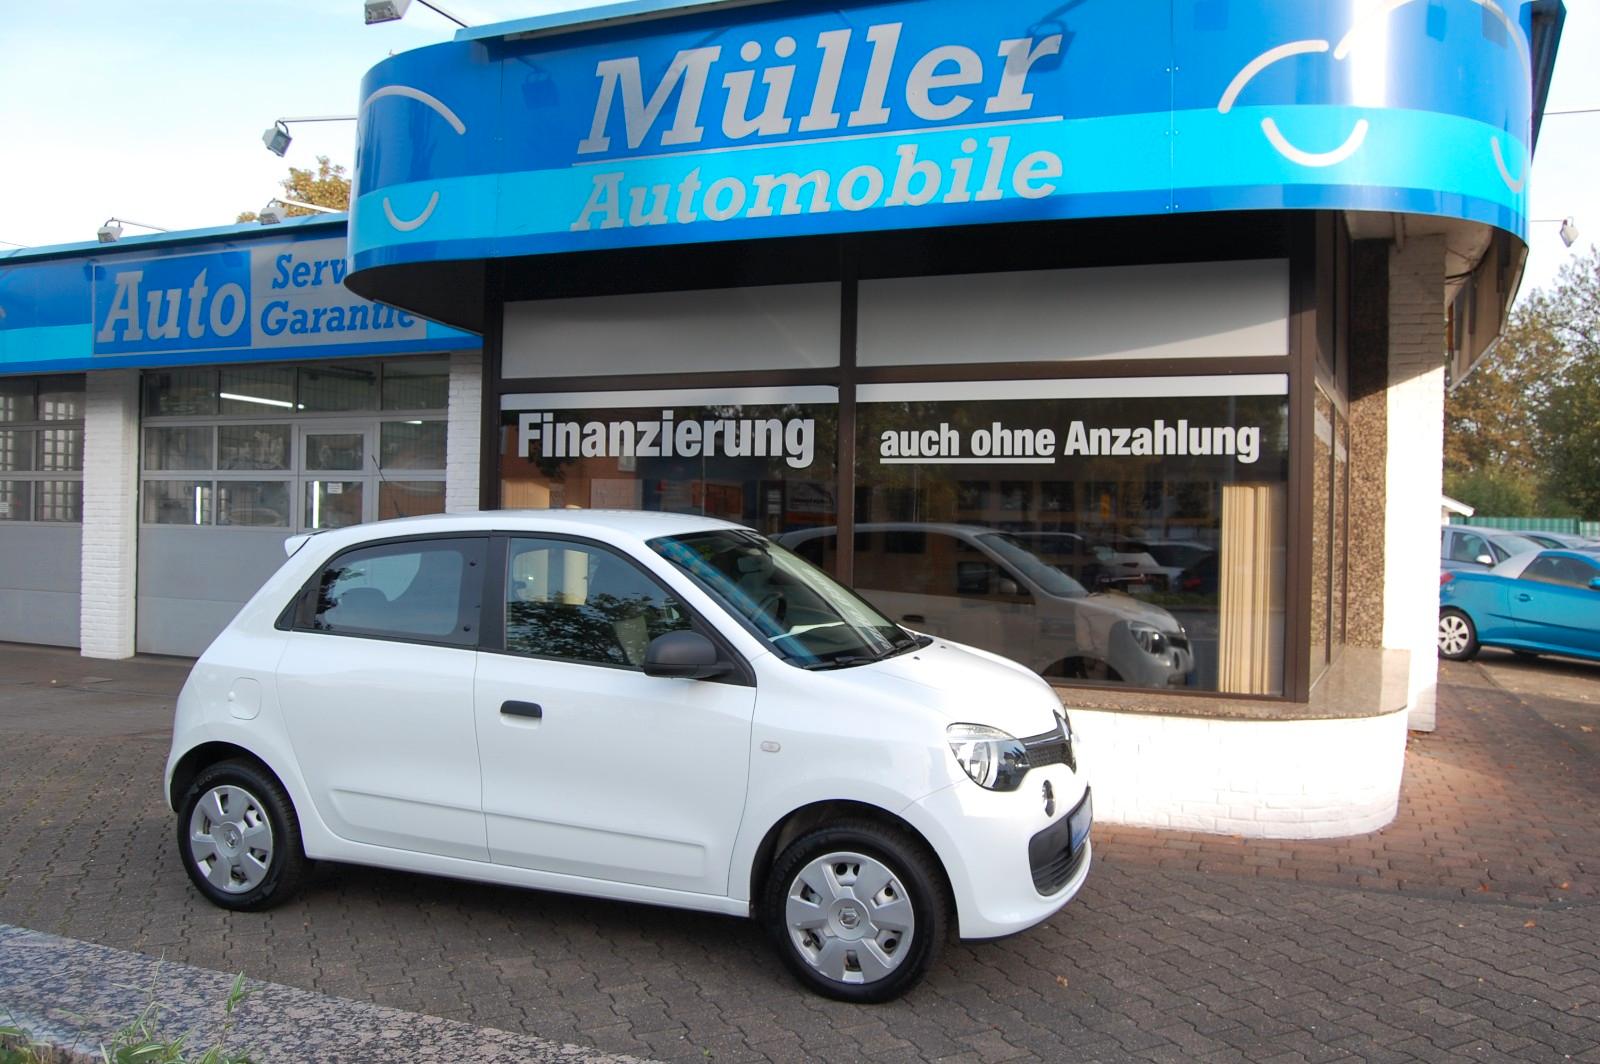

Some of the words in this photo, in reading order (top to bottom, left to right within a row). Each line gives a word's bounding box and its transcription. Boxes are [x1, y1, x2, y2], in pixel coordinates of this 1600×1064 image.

[577, 22, 1063, 155] Müller
[569, 135, 1064, 232] Automobile
[272, 253, 347, 289] Serv
[96, 267, 246, 343] Auto
[518, 410, 815, 469] Finanzierung
[880, 422, 960, 457] auch
[970, 421, 1056, 457] ohne
[1064, 419, 1261, 464] Anzahlung
